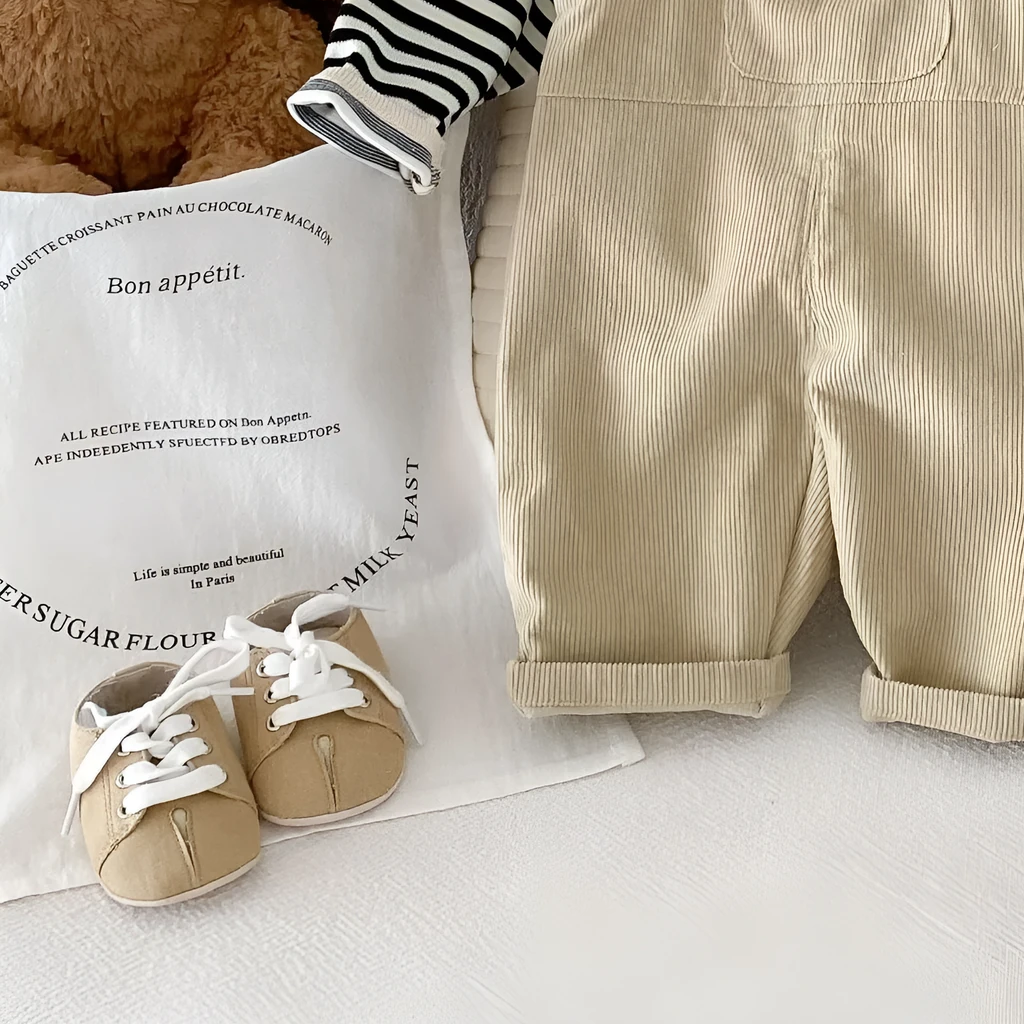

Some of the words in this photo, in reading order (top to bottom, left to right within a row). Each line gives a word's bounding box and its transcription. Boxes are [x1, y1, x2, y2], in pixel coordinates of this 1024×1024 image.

[0, 241, 58, 290] BAGUETTE
[57, 214, 133, 247] CROISSANT
[137, 206, 173, 222] PAIN
[175, 203, 195, 215] AU
[197, 201, 283, 220] CHOCOLATE
[284, 211, 333, 246] MACARON
[107, 277, 151, 294] Bon
[158, 262, 245, 294] appétit.
[60, 431, 88, 443] ALL
[91, 422, 141, 438] RECIPE
[144, 419, 216, 431] FEATURED
[219, 418, 238, 429] ON
[241, 436, 258, 446] BY
[261, 423, 341, 445] OBREDTOPS
[341, 546, 404, 593] MILK
[395, 457, 419, 542] YEAST
[133, 567, 157, 581] Life
[213, 555, 233, 569] and
[206, 573, 235, 588] Paris
[0, 578, 32, 615] ER
[32, 603, 120, 650] SUGAR
[124, 631, 216, 651] FLOUR
